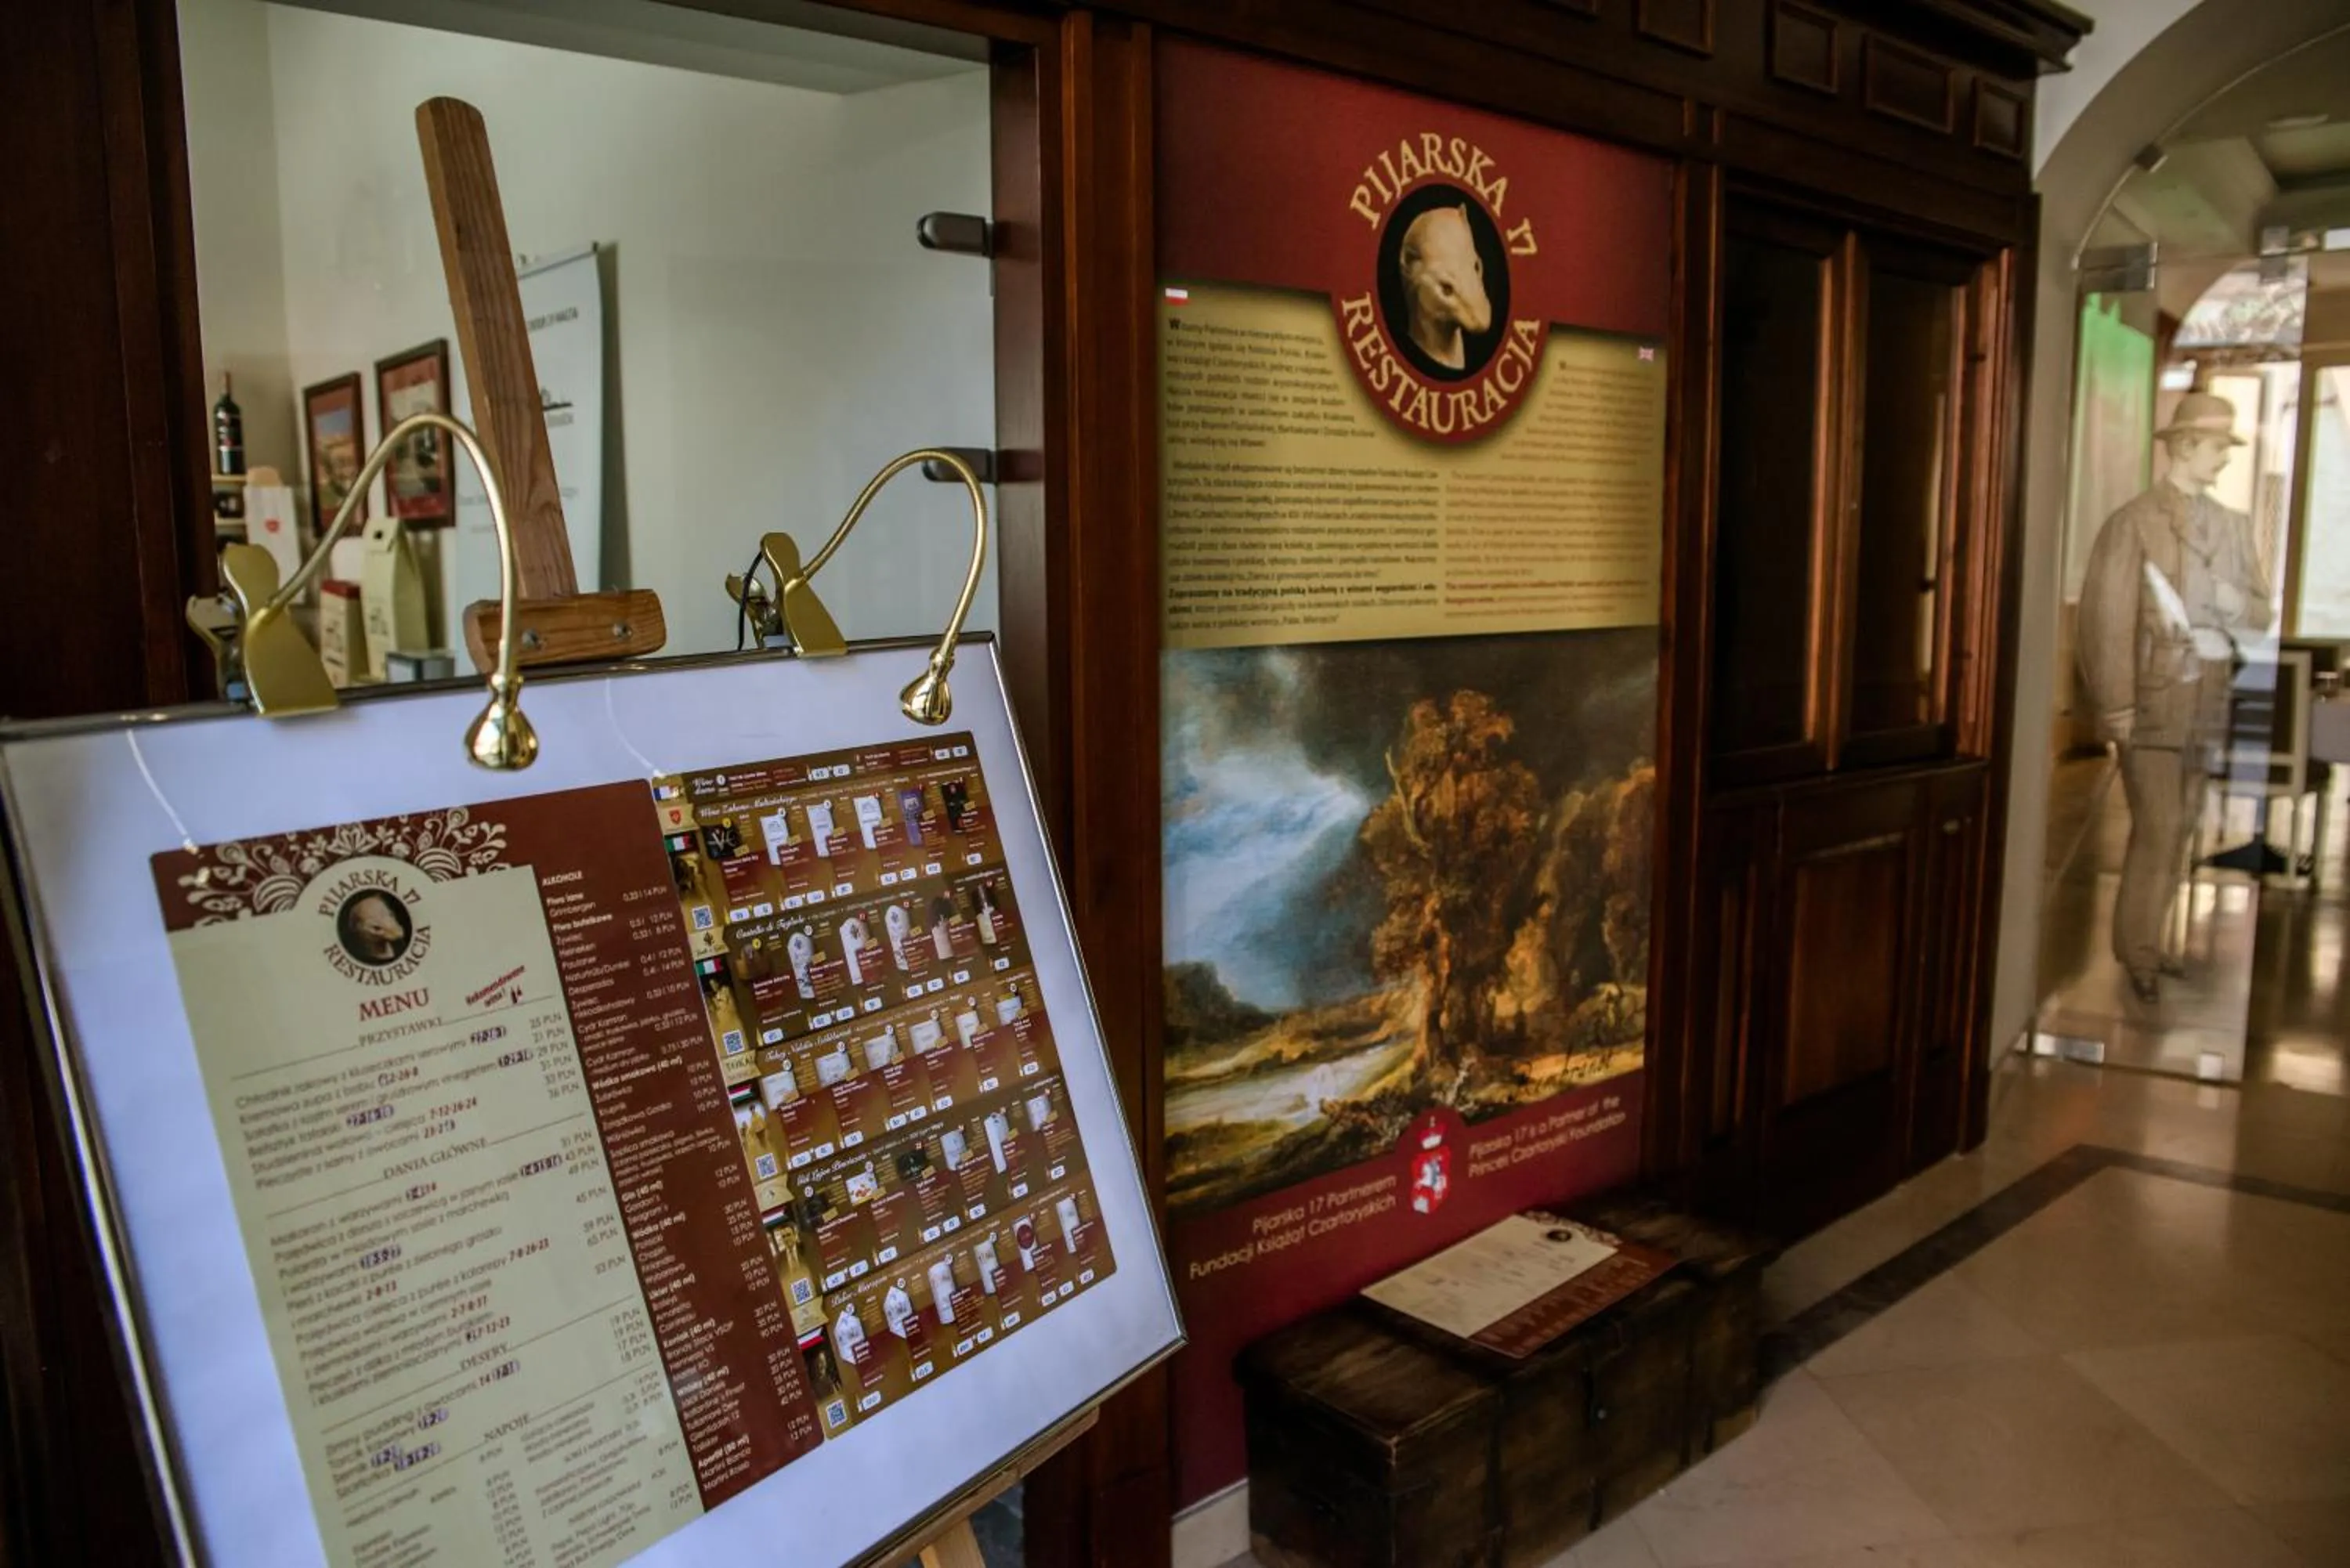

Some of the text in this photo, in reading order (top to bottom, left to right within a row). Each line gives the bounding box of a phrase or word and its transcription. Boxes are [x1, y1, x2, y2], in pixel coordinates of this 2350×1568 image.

[1350, 132, 1538, 256] PIJARSKA 17
[1341, 291, 1541, 435] RESTAURACJA
[541, 871, 582, 885] ALKOHOLE
[319, 869, 421, 919] PIJARSKA 17
[324, 924, 432, 988] RESTAURACJA
[359, 988, 430, 1022] MENU
[529, 1017, 540, 1027] 25
[542, 1012, 561, 1024] PLN
[358, 1015, 443, 1048] PRZYSTAWKI
[546, 1026, 565, 1038] PLN
[549, 1040, 568, 1053] PLN
[552, 1054, 571, 1067] PLN
[556, 1068, 575, 1081] PLN
[561, 1082, 579, 1094] PLN
[1469, 1096, 1621, 1159] Pijarska 17 is a Partner of the
[573, 1129, 591, 1142] PLN
[577, 1143, 595, 1157] PLN
[1468, 1112, 1627, 1178] Princes Czartoryski Foundation
[382, 1157, 427, 1181] DANIA
[428, 1136, 489, 1167] GŁÓWNE
[580, 1157, 598, 1170] PLN
[588, 1186, 606, 1199] PLN
[1253, 1174, 1397, 1234] Pijarska 17 Partnerem
[595, 1212, 613, 1227] PLN
[599, 1227, 617, 1241] PLN
[1189, 1194, 1397, 1280] Fundacji Książąt Czartoryskich
[607, 1254, 625, 1269] PLN
[622, 1306, 639, 1321] PLN
[626, 1319, 642, 1333] PLN
[629, 1331, 646, 1346] PLN
[460, 1342, 508, 1371] DESERY
[632, 1342, 649, 1357] PLN
[483, 1414, 532, 1443] NAPOJE
